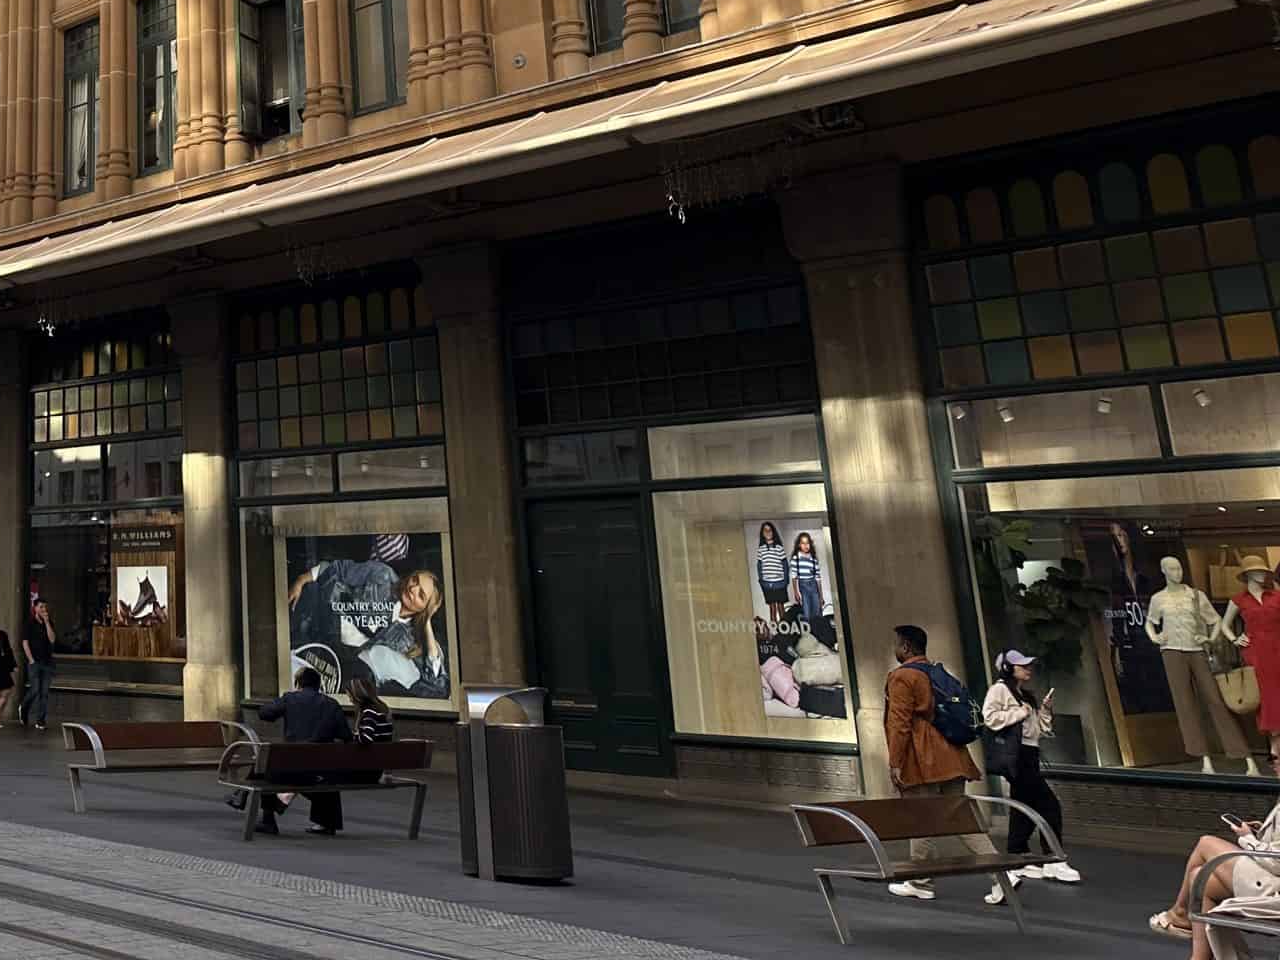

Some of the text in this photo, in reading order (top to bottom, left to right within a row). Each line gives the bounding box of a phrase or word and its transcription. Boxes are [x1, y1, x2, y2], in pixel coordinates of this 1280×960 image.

[332, 602, 395, 611] COUNTRY ROAD
[355, 616, 388, 628] YEARS
[698, 620, 811, 635] COUNTRY ROAD
